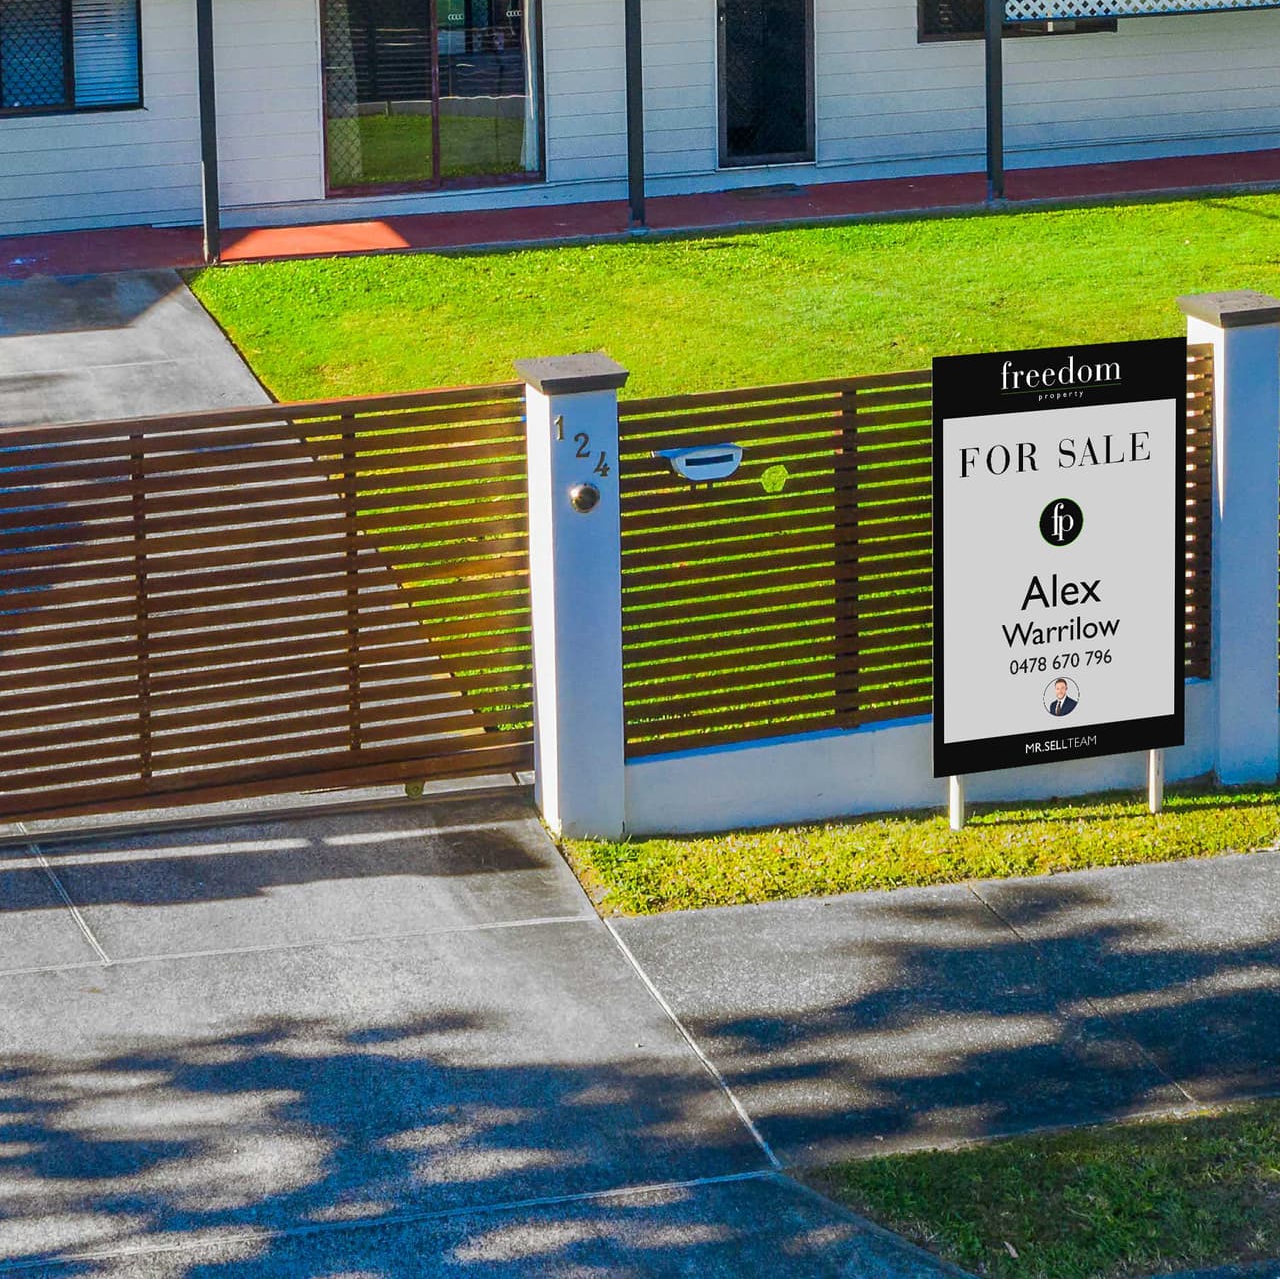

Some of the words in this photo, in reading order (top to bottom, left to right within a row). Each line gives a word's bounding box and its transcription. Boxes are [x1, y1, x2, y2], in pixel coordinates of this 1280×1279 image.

[1000, 356, 1122, 391] freedom
[1038, 390, 1084, 402] property
[553, 414, 611, 478] 124
[959, 442, 1039, 478] FOR
[1058, 431, 1152, 469] SALE
[1020, 573, 1102, 611] Alex
[1002, 616, 1120, 648] Warrilow
[1009, 656, 1047, 675] 0478
[1052, 652, 1080, 670] 670
[1085, 649, 1113, 666] 796
